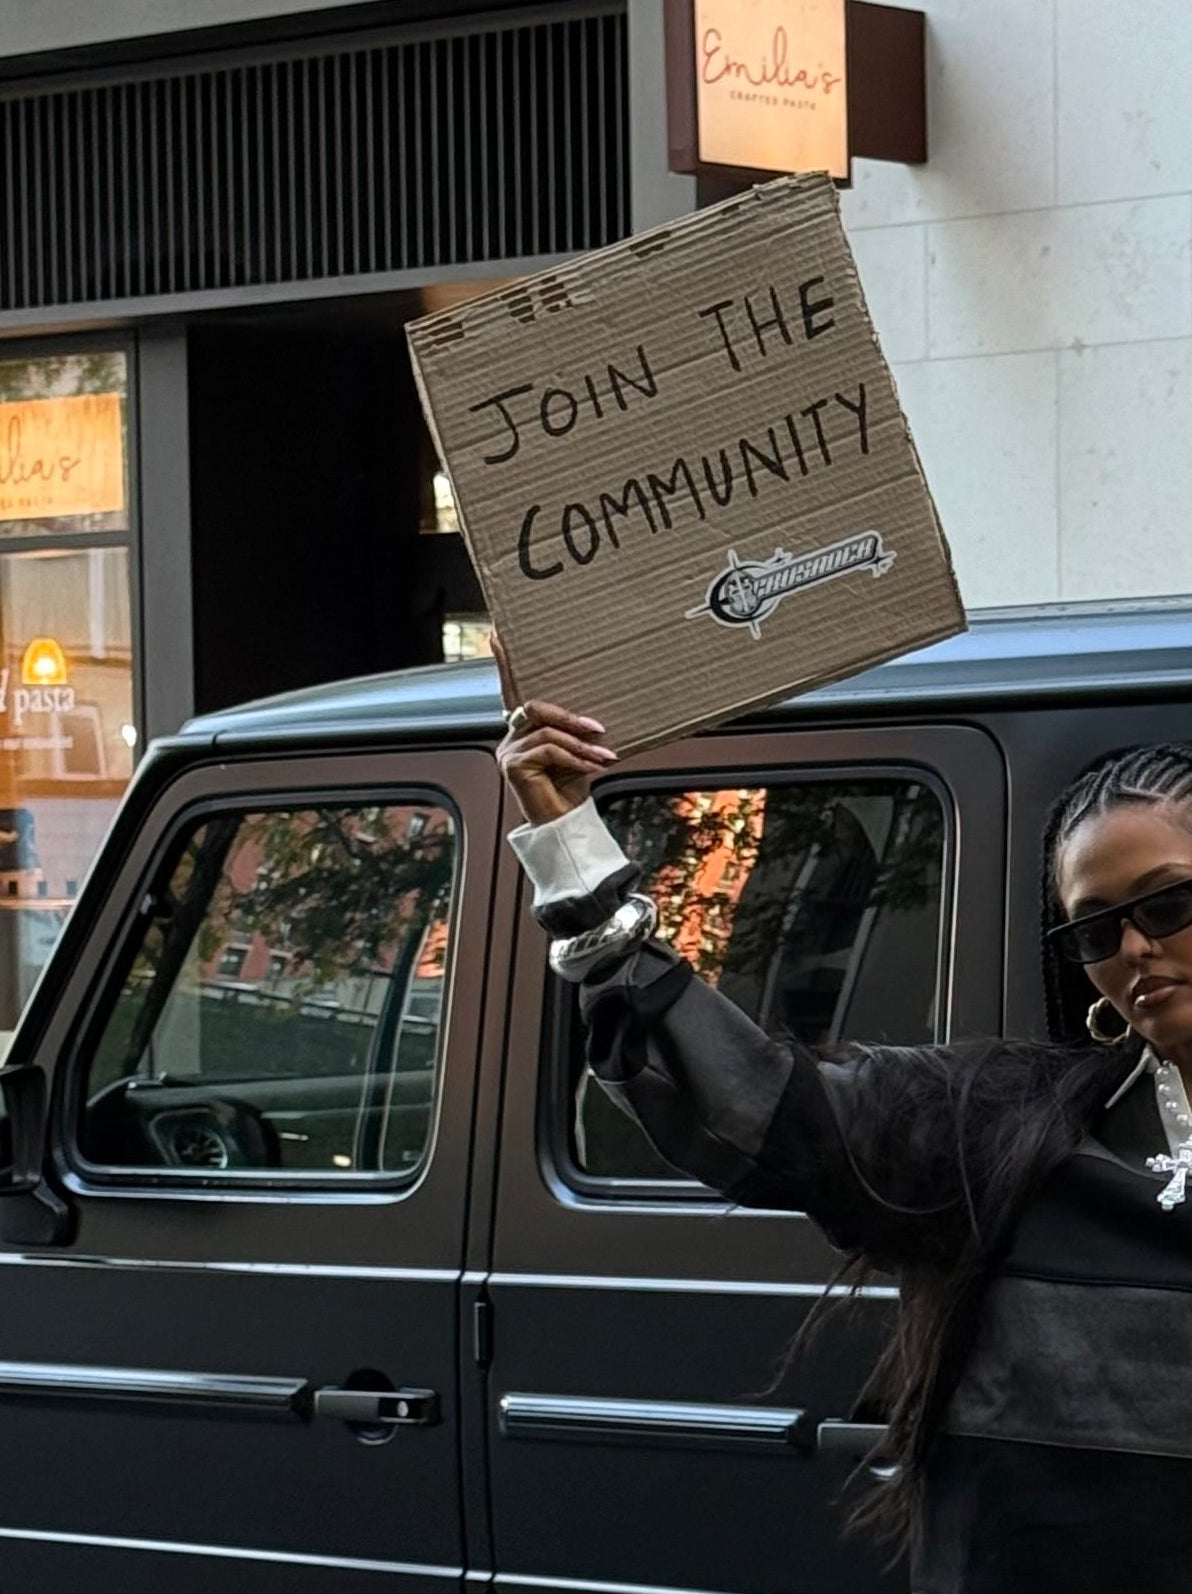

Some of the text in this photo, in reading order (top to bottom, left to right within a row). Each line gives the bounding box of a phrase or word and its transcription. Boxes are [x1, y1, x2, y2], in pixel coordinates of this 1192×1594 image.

[702, 26, 842, 94] Emilia's
[468, 275, 836, 466] JOIN THE
[517, 382, 871, 581] COMMUNITY
[13, 686, 76, 726] pasta
